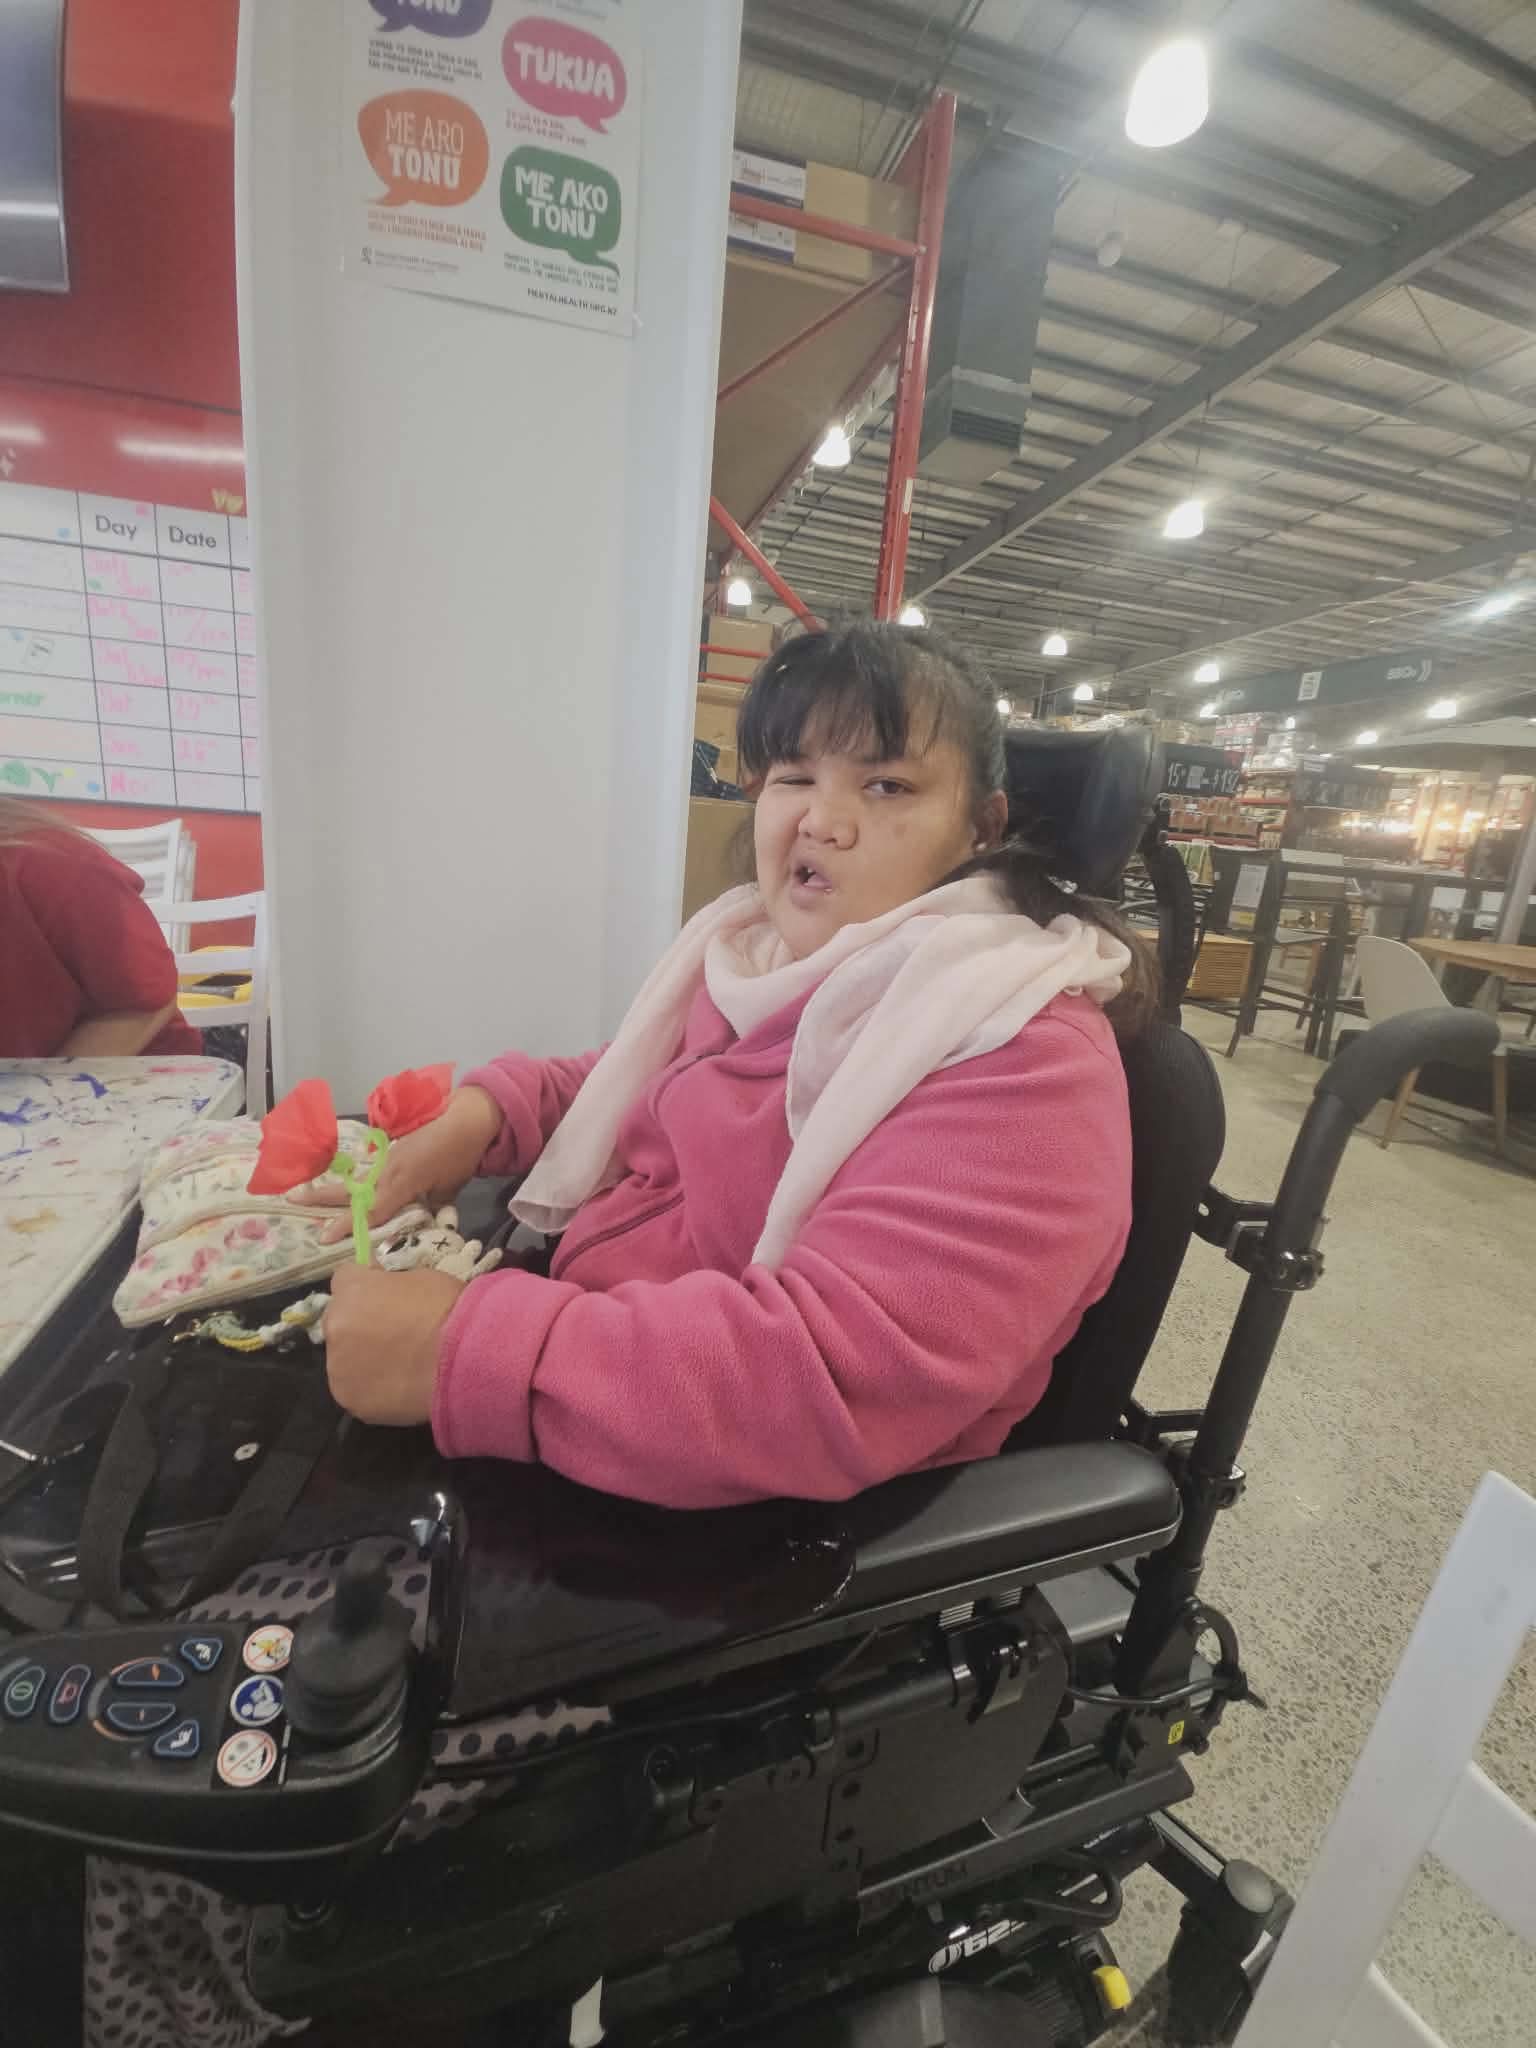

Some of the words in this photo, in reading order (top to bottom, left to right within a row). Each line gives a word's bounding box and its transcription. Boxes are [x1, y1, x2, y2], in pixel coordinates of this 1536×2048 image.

[513, 41, 615, 102] TUKUA
[385, 107, 416, 146] ME
[421, 115, 464, 156] ARO
[387, 145, 461, 190] TONU
[514, 166, 554, 201] ME
[560, 178, 609, 215] AKO
[526, 198, 597, 239] TONU
[95, 514, 137, 541] Day
[168, 524, 217, 549] Date
